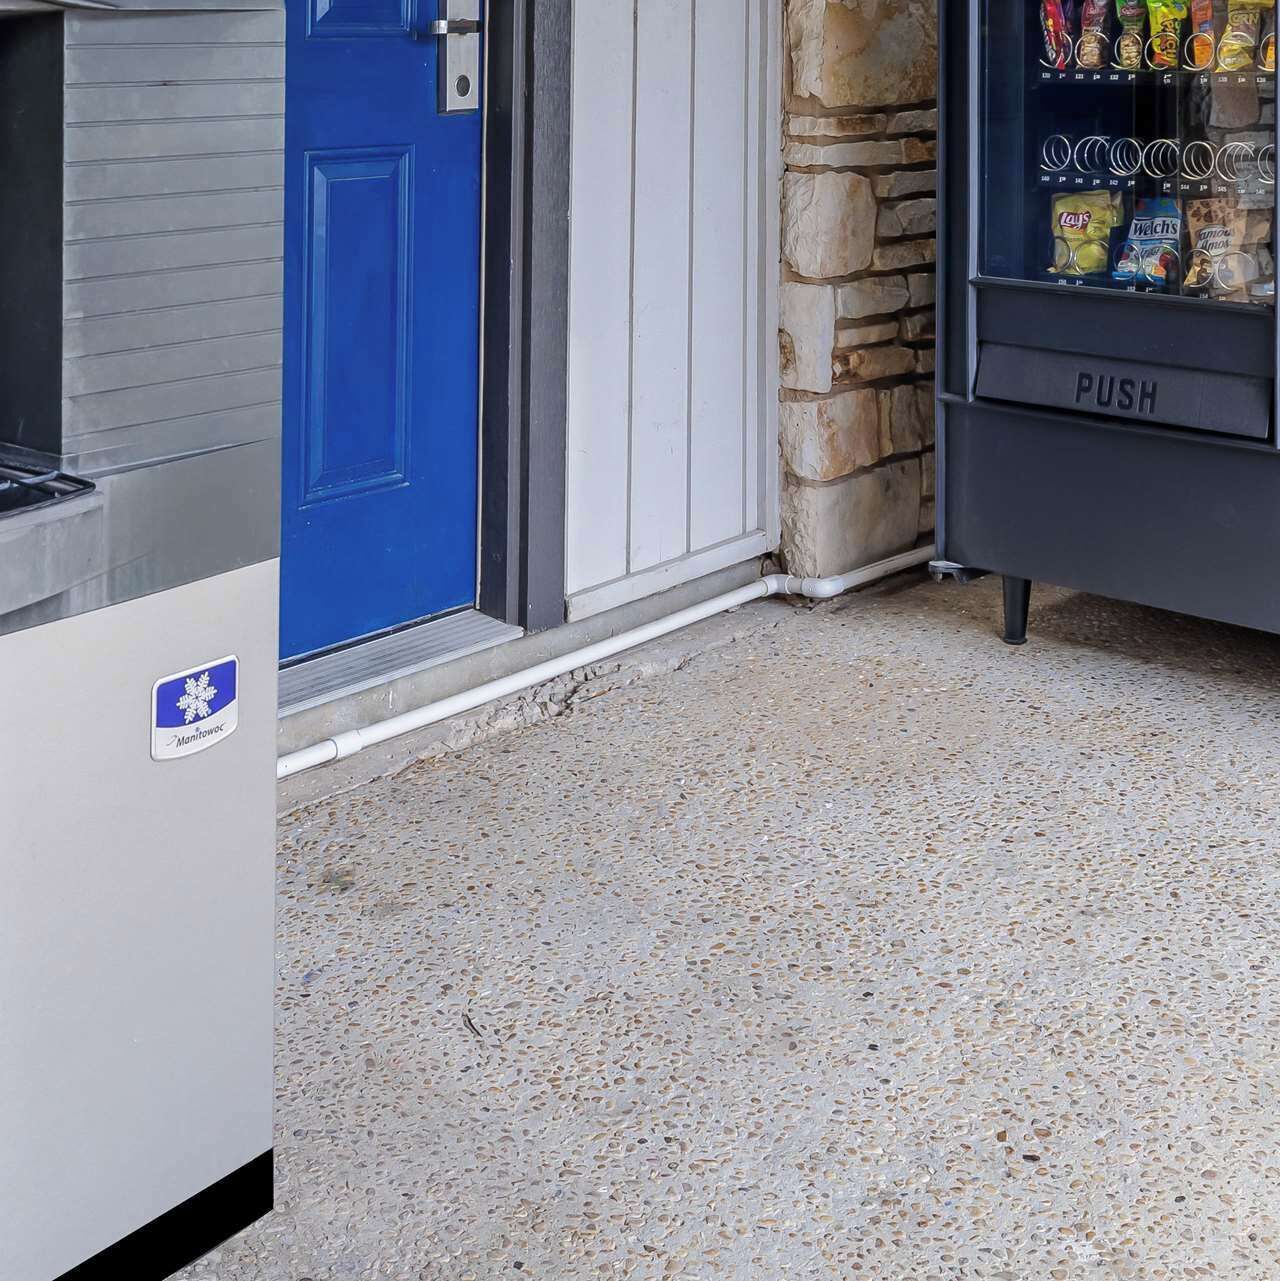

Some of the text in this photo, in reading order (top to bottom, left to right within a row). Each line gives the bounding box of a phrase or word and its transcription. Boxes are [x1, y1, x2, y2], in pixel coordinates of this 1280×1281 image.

[1133, 219, 1178, 235] Welch's
[1075, 371, 1158, 415] PUSH
[175, 721, 226, 748] Manitowoc
